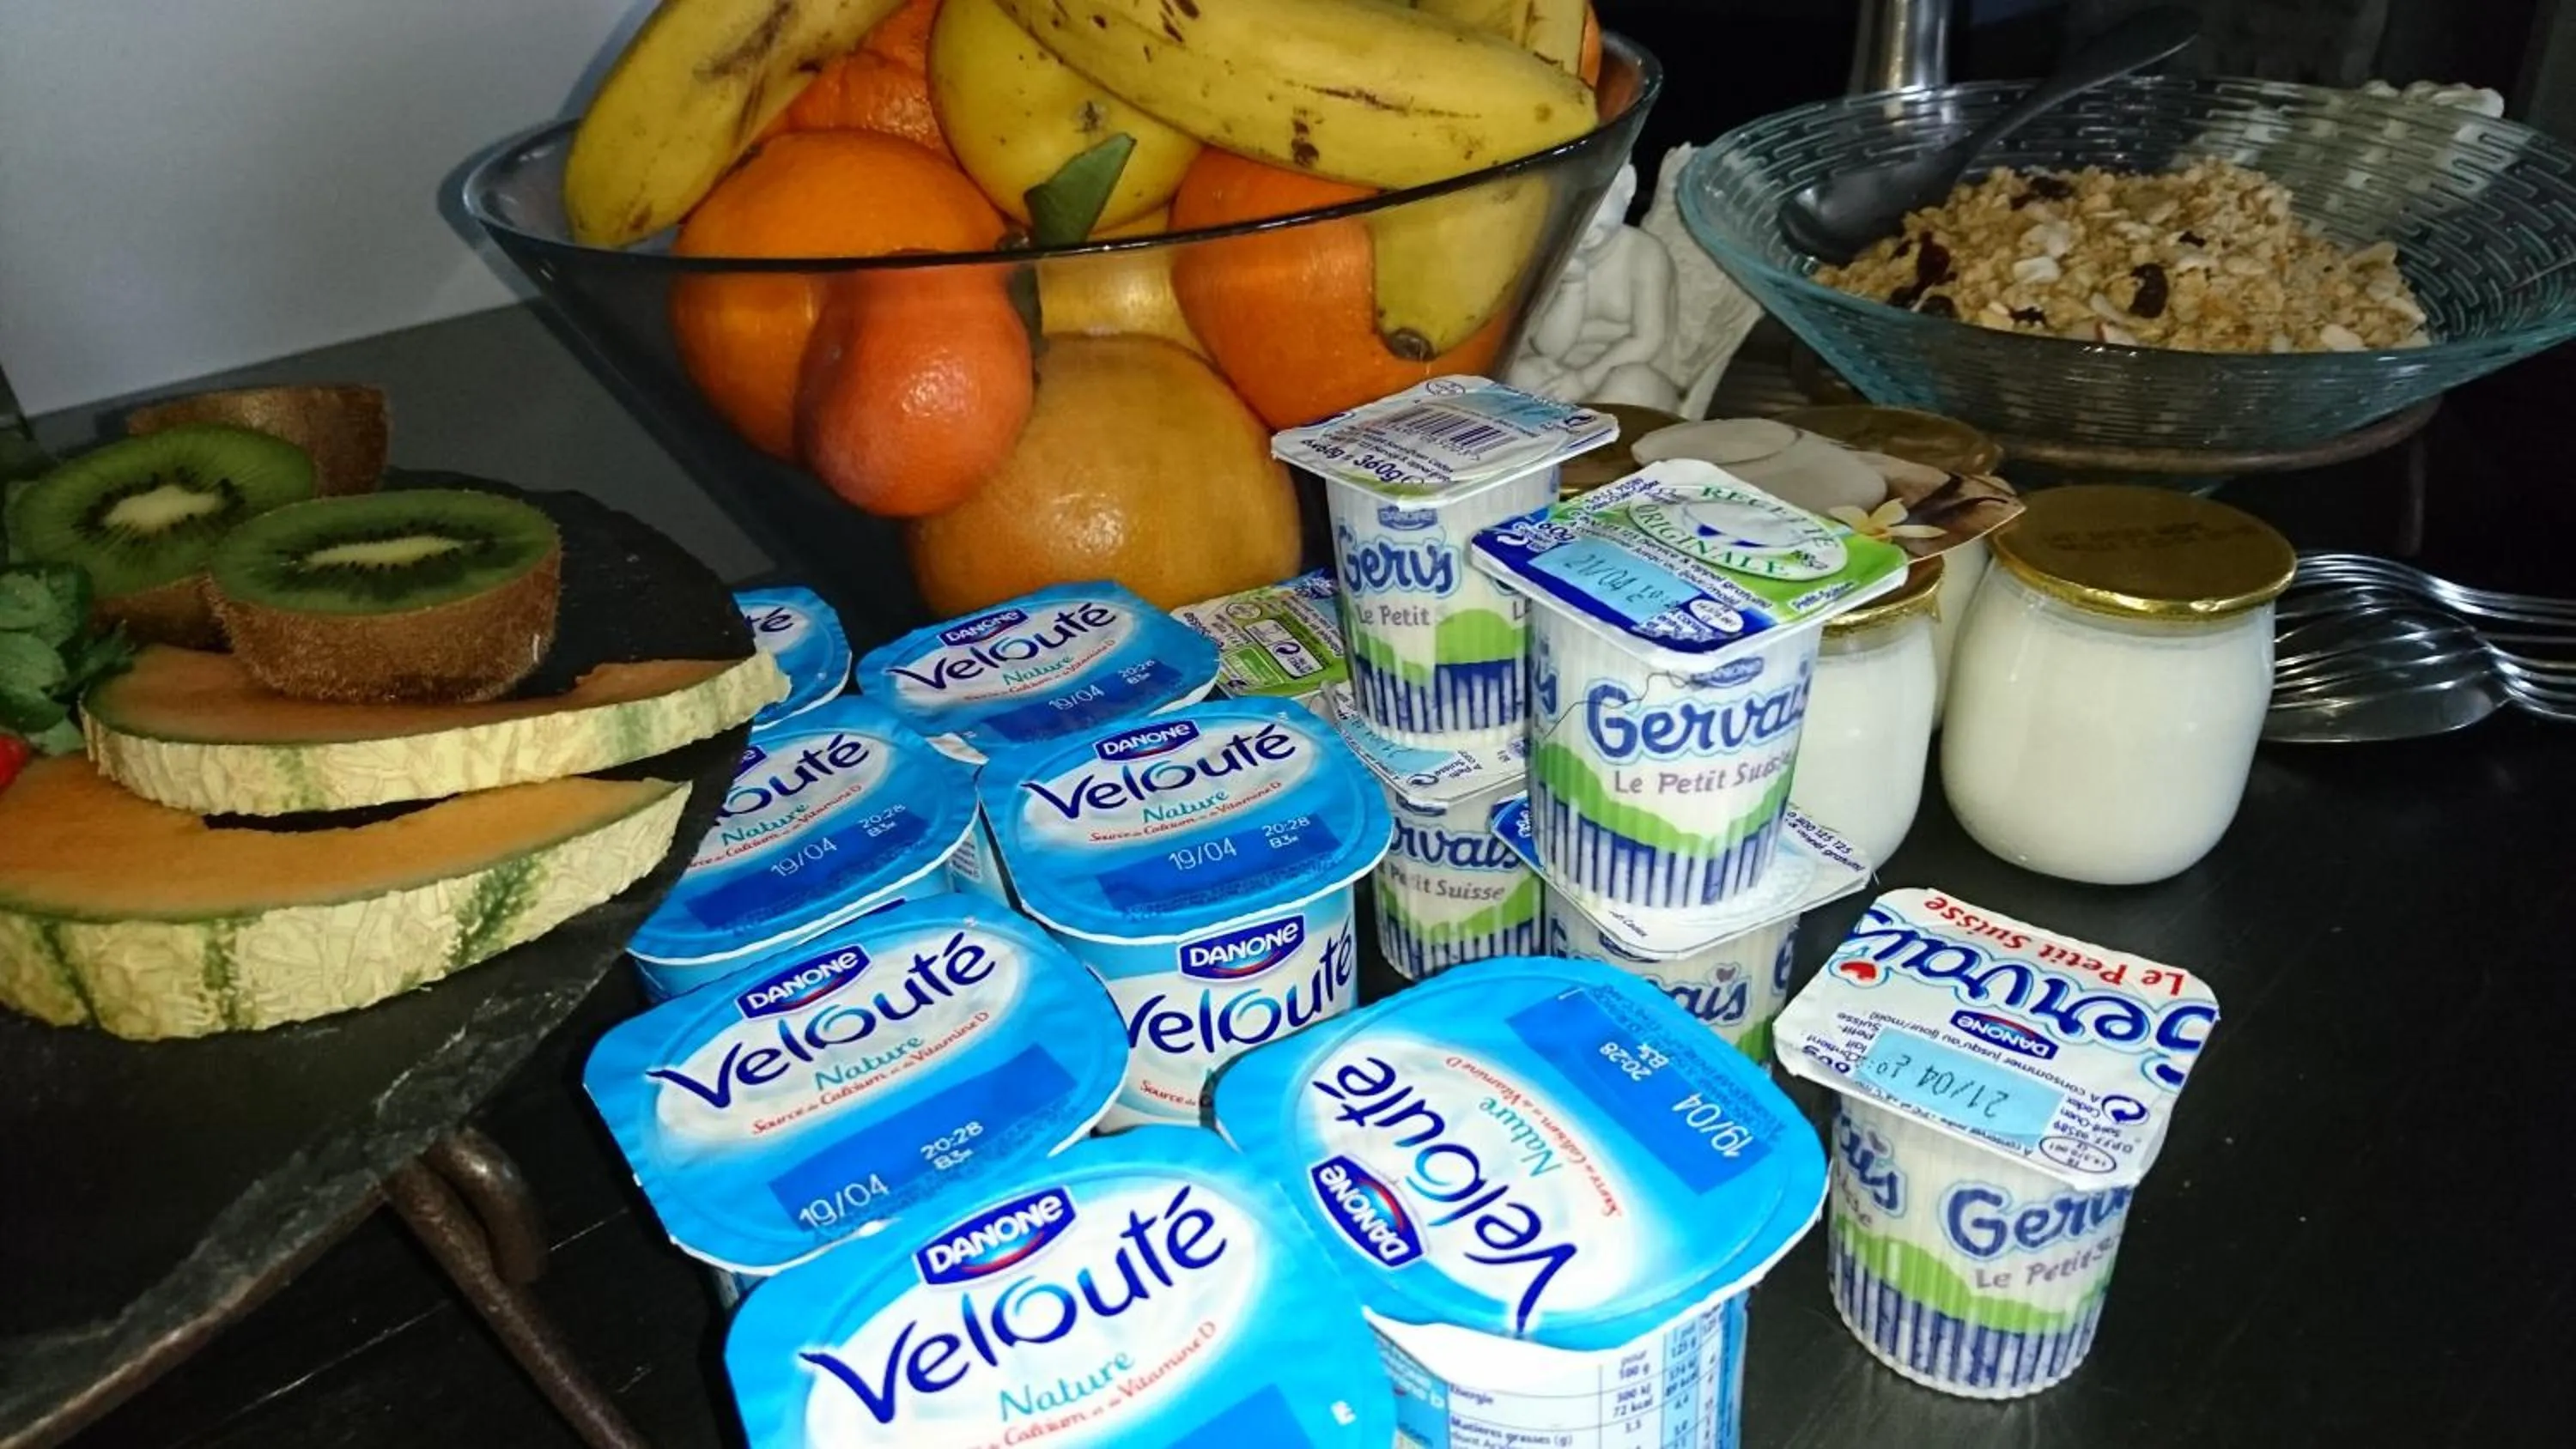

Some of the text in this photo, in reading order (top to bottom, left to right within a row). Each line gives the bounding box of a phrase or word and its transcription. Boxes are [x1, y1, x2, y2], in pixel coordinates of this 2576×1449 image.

[1352, 454, 1404, 482] 360g
[1699, 486, 1838, 549] RECETTE
[1634, 503, 1791, 577] ORIGINALE
[946, 610, 1021, 641] DANONE
[1379, 603, 1431, 626] Petit
[884, 602, 1117, 691] Velouté
[1002, 655, 1074, 686] Nature
[1048, 684, 1106, 711] 19/04
[1103, 722, 1192, 757] DANONE
[1018, 723, 1297, 822] Velouté
[1613, 770, 1642, 795] Le
[1657, 768, 1725, 796] Petit
[720, 802, 811, 846] Nature
[1142, 788, 1230, 824] Nature
[1261, 816, 1311, 838] 20:28
[769, 836, 838, 877] 19/04
[1168, 836, 1237, 871] 19/04
[1435, 879, 1506, 900] Suisse
[1189, 921, 1300, 967] DANONE
[1923, 895, 2185, 996] Le Petit Suisse
[746, 951, 859, 1011] DANONE
[646, 930, 997, 1109] Velouté
[1836, 1012, 1883, 1032] Suisse
[1956, 1015, 2050, 1058] DANONE
[813, 1035, 925, 1092] Nature
[1599, 1040, 1653, 1082] 20:28
[1845, 1039, 1868, 1054] lait
[1941, 1034, 2002, 1064] jusqu'au
[751, 1106, 804, 1135] Source
[819, 1071, 888, 1106] Calcium
[909, 1022, 976, 1064] Vitamine
[1139, 1079, 1186, 1105] Source
[1461, 1061, 1524, 1103] Vitamine
[1916, 1064, 2011, 1119] 21/04
[2002, 1057, 2087, 1096] consommer
[920, 1119, 984, 1161] 20:28
[1478, 1095, 1564, 1178] Nature
[1670, 1092, 1754, 1160] 19/04
[798, 1173, 891, 1229] 19/04
[1311, 1056, 1579, 1334] Velouté
[1319, 1163, 1411, 1262] DANONE
[927, 1194, 1065, 1275] DANONE
[1977, 1268, 2012, 1289] Le
[797, 1183, 1229, 1425] Velouté
[998, 1350, 1135, 1423] Nature
[1003, 1411, 1086, 1447] Calcium
[1117, 1340, 1201, 1399] Vitamine
[1198, 1319, 1218, 1340] D
[1553, 1433, 1574, 1447] (g)
